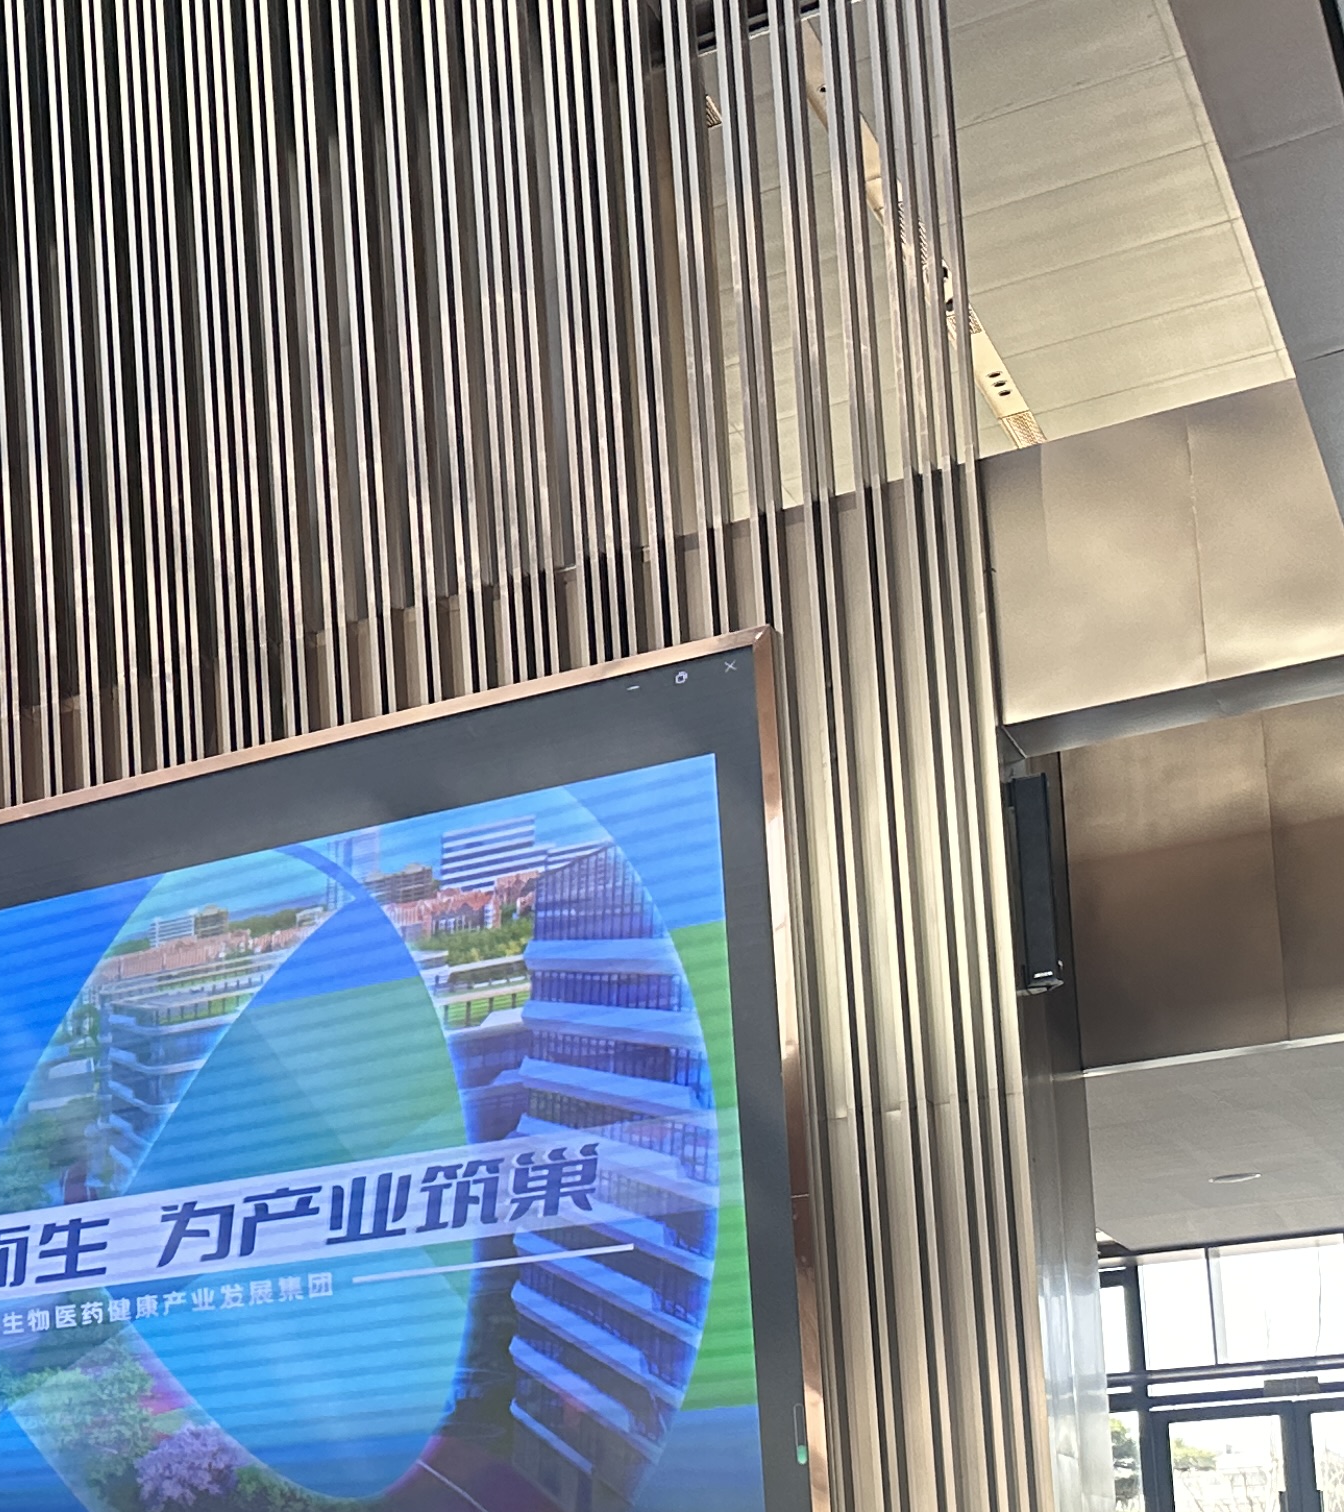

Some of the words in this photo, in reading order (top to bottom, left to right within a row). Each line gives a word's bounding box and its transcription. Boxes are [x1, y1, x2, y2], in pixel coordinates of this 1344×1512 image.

[157, 1142, 601, 1265] 为产业筑巢
